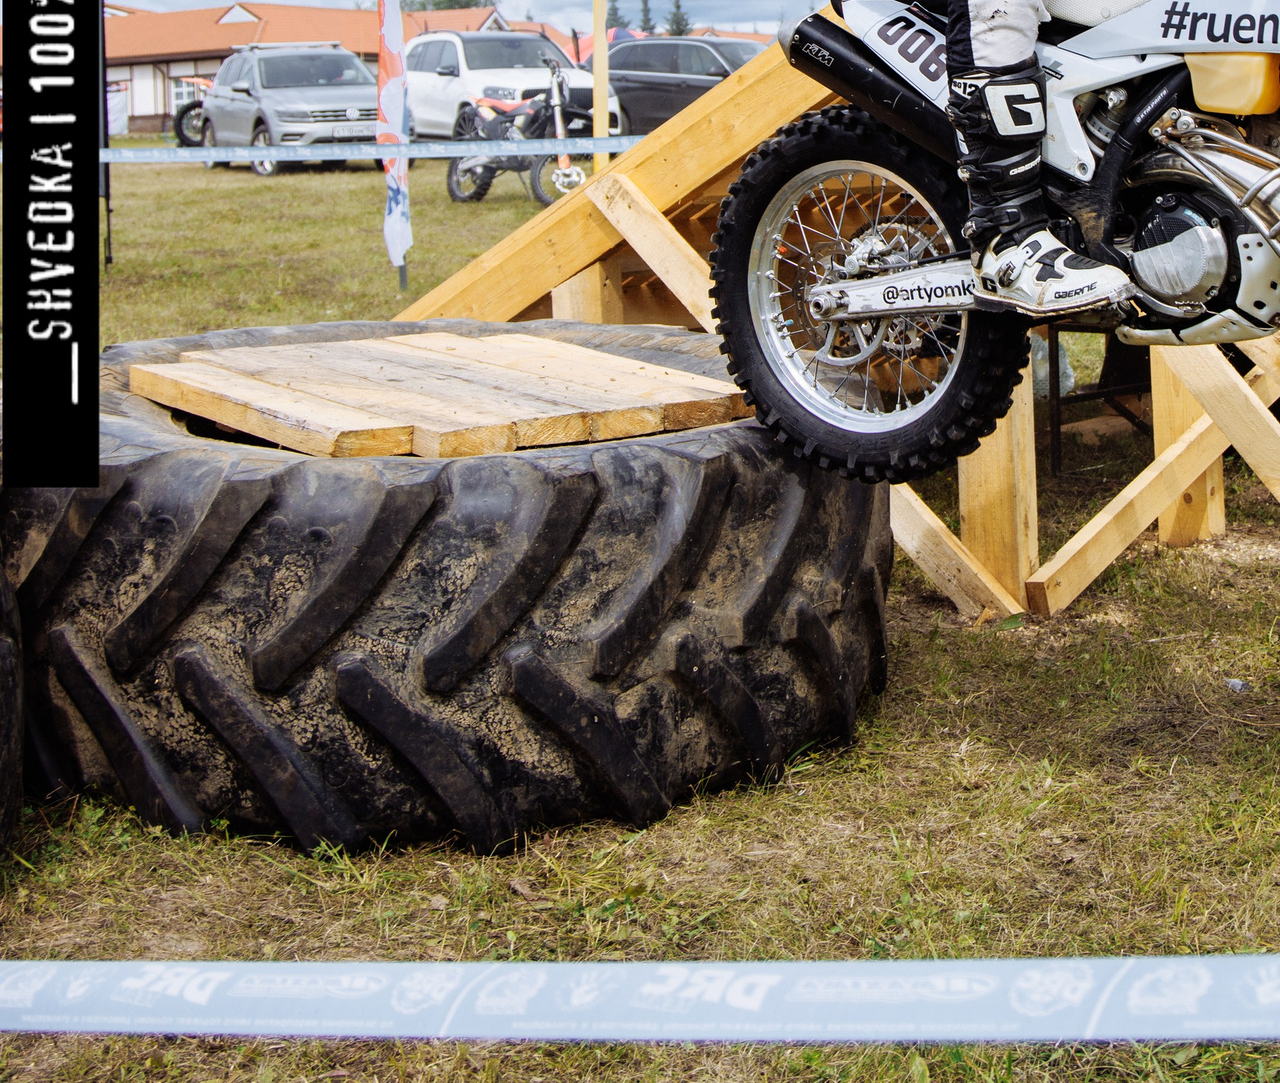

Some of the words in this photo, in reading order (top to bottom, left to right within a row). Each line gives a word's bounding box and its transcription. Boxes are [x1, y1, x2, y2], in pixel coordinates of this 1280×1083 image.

[802, 42, 835, 67] KTM
[877, 15, 948, 82] 006
[984, 83, 1046, 136] G
[1053, 281, 1098, 300] GAERNE
